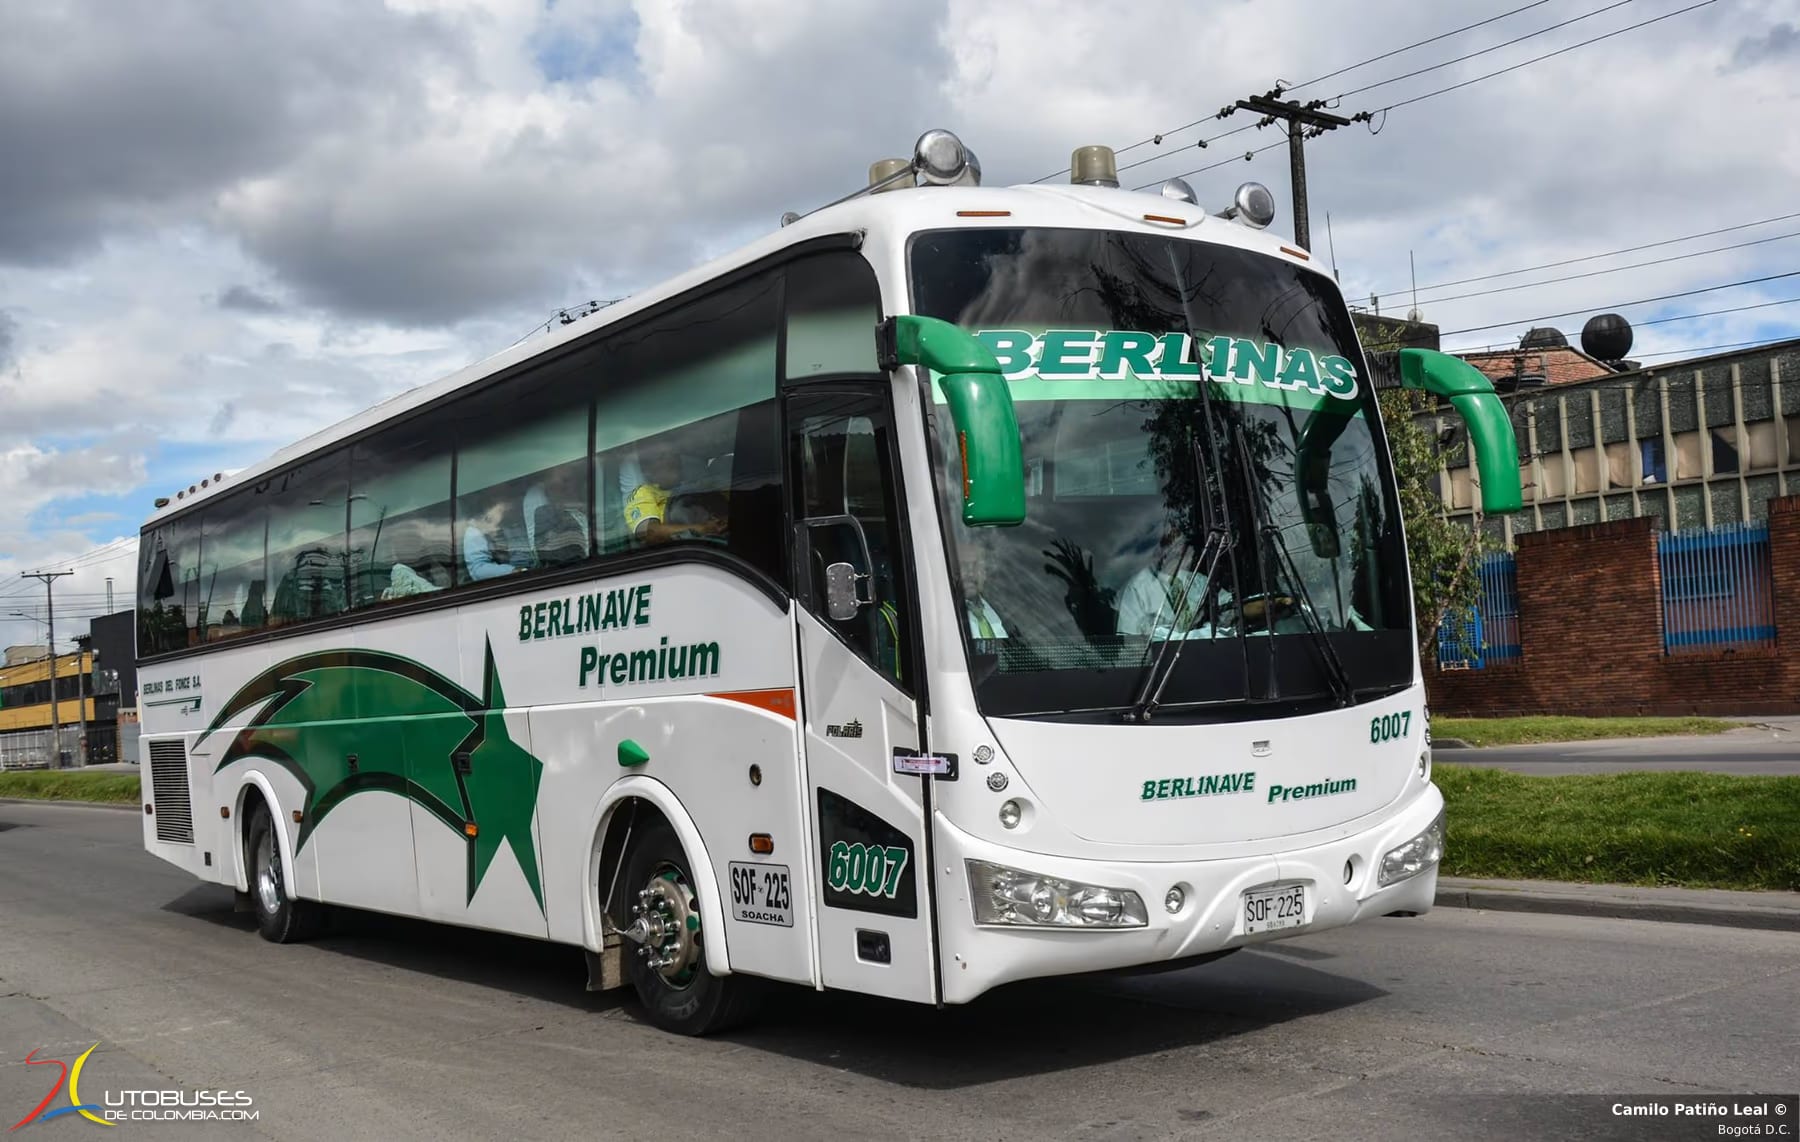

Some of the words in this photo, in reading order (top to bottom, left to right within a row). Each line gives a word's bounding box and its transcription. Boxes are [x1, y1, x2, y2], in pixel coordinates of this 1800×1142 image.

[972, 328, 1359, 399] BERLINAS
[518, 584, 653, 643] BERLINAVE
[578, 636, 721, 689] Premium
[826, 722, 862, 738] POLARIS
[1370, 710, 1412, 744] 6007
[1140, 771, 1256, 802] BERLINAVE
[1267, 776, 1357, 802] Premium
[828, 840, 908, 899] 6007
[741, 910, 785, 923] SOACHA
